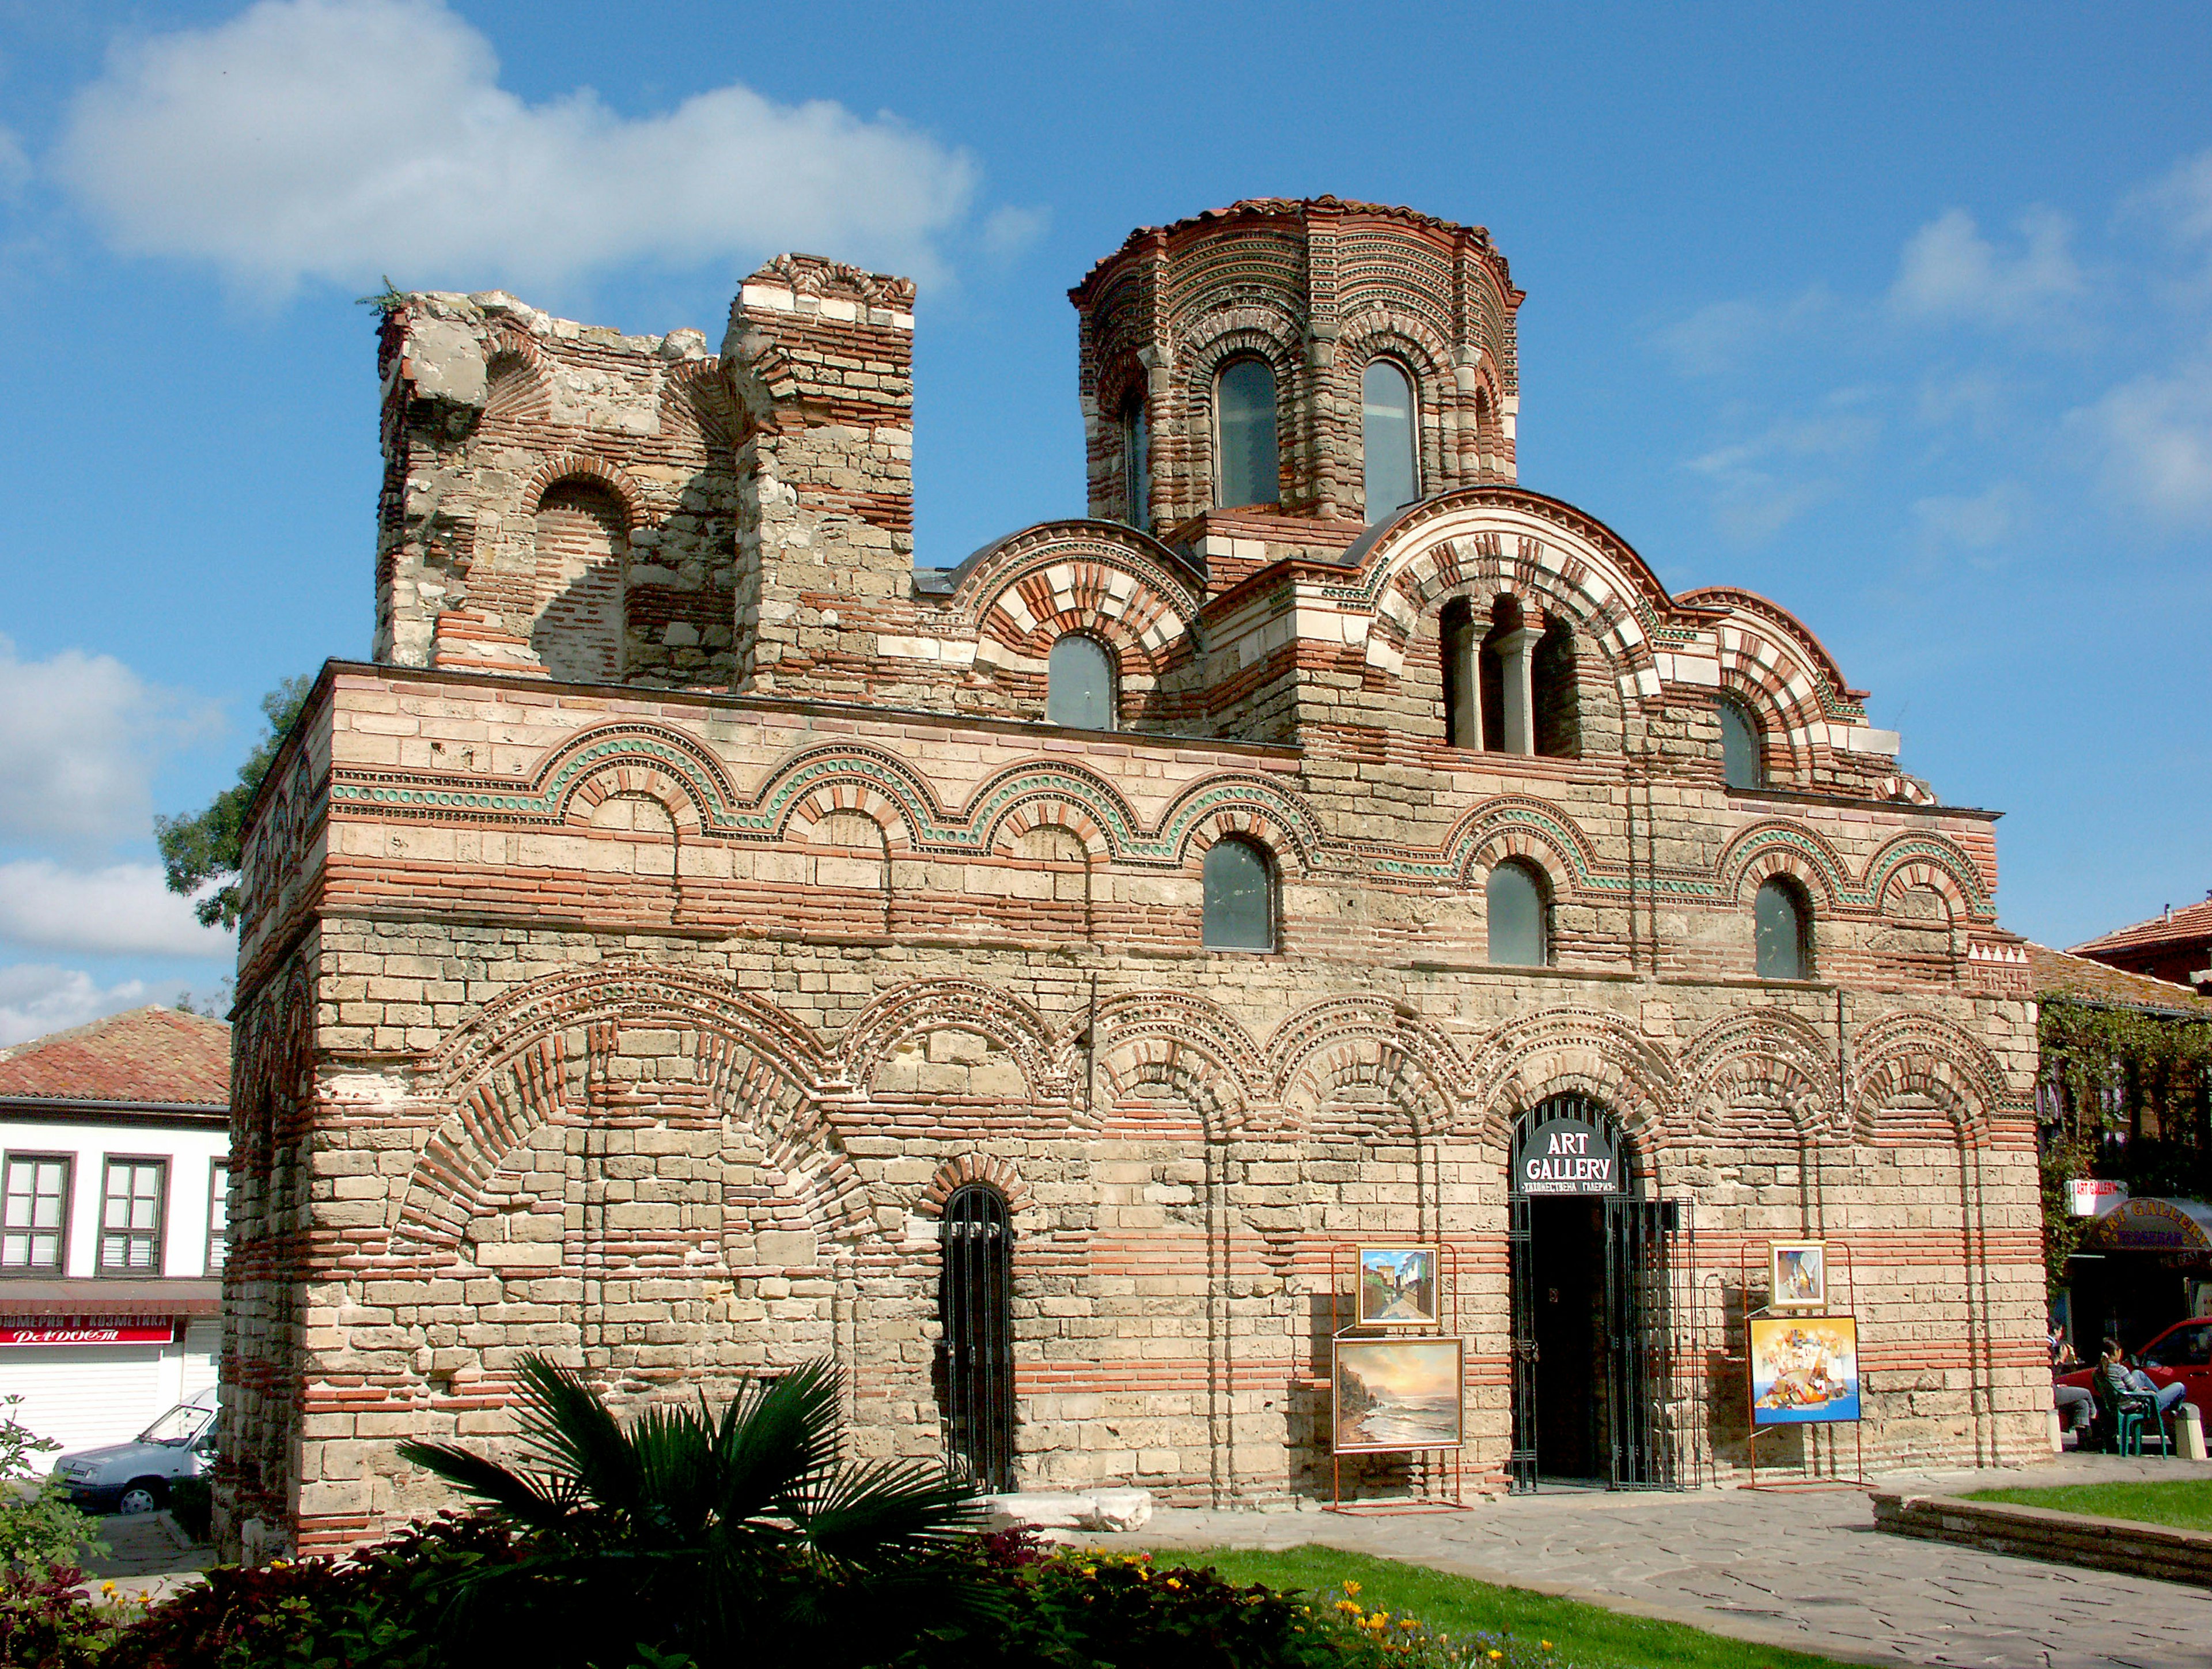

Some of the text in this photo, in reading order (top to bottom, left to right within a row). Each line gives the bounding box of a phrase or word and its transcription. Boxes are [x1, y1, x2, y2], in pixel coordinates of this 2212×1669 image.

[1547, 1132, 1589, 1155] ART
[1526, 1158, 1611, 1180] GALLERY
[2077, 1182, 2088, 1195] ART
[0, 1315, 65, 1327] ЮМЕРИЯ
